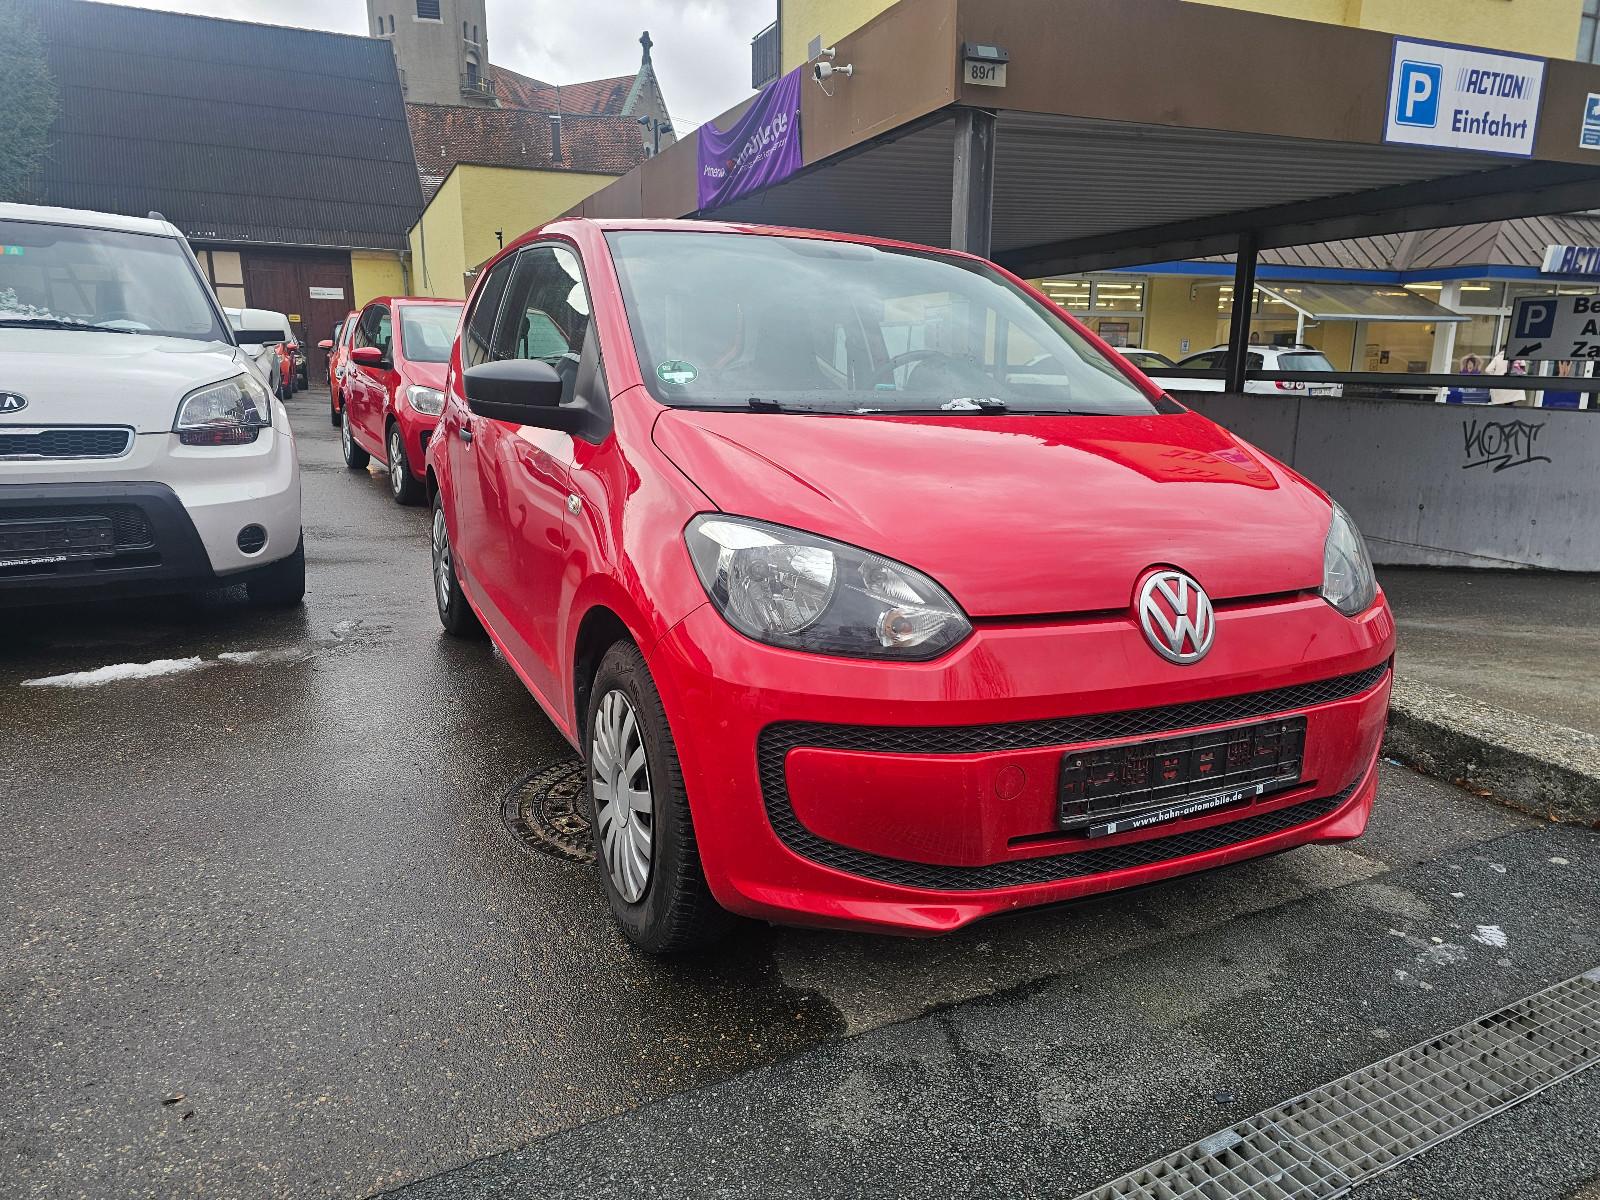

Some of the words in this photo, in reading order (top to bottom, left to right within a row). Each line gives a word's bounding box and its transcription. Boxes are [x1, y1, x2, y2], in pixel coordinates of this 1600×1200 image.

[971, 64, 996, 81] 89/1
[1466, 69, 1525, 99] ACTION
[1405, 71, 1432, 117] P
[1451, 109, 1528, 139] Einfahrt
[1561, 245, 1600, 273] ACTI
[1524, 305, 1548, 334] P
[1580, 319, 1600, 336] A
[0, 396, 19, 408] A
[1142, 573, 1211, 660] VW
[1132, 791, 1243, 828] www.hahn-automobile.de
